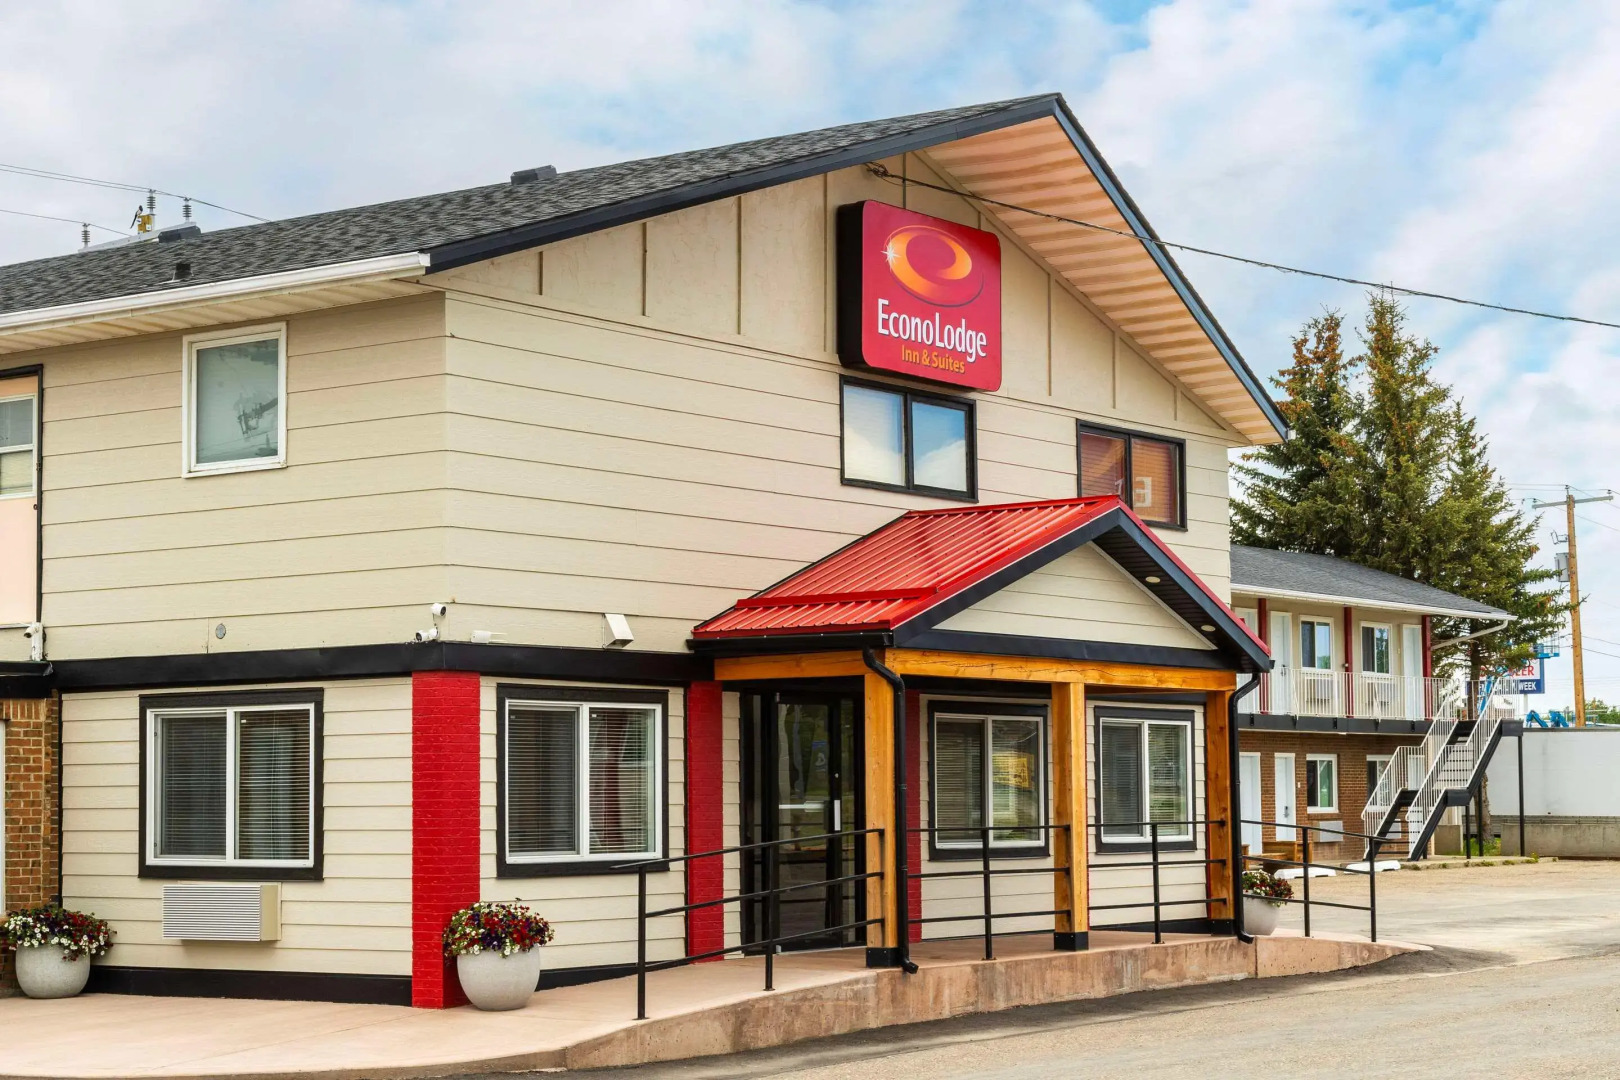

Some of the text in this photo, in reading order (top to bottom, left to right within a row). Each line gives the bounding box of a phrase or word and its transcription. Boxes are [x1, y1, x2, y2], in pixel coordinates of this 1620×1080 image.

[878, 298, 987, 362] EconoLodge
[902, 344, 965, 373] Inn & Suites
[1518, 681, 1536, 690] WEEK
